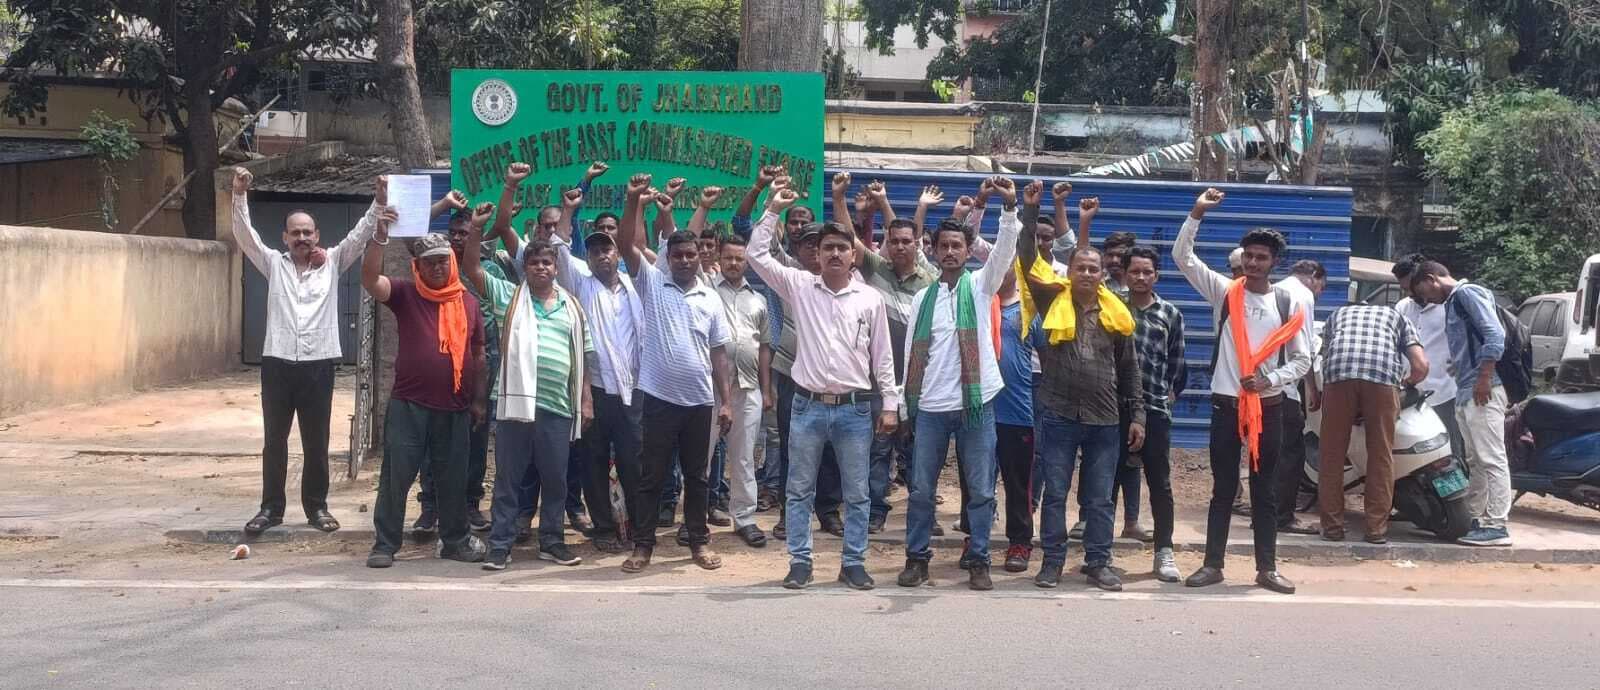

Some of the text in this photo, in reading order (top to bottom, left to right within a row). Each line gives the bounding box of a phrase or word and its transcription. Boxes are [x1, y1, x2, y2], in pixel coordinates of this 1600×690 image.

[547, 82, 782, 114] GOVT. OF JHARKHAND
[460, 141, 514, 196] OFFICE
[519, 134, 539, 176] OF
[541, 126, 573, 169] THE
[578, 121, 621, 164] ASST.
[627, 120, 752, 178] COMMISSIONER
